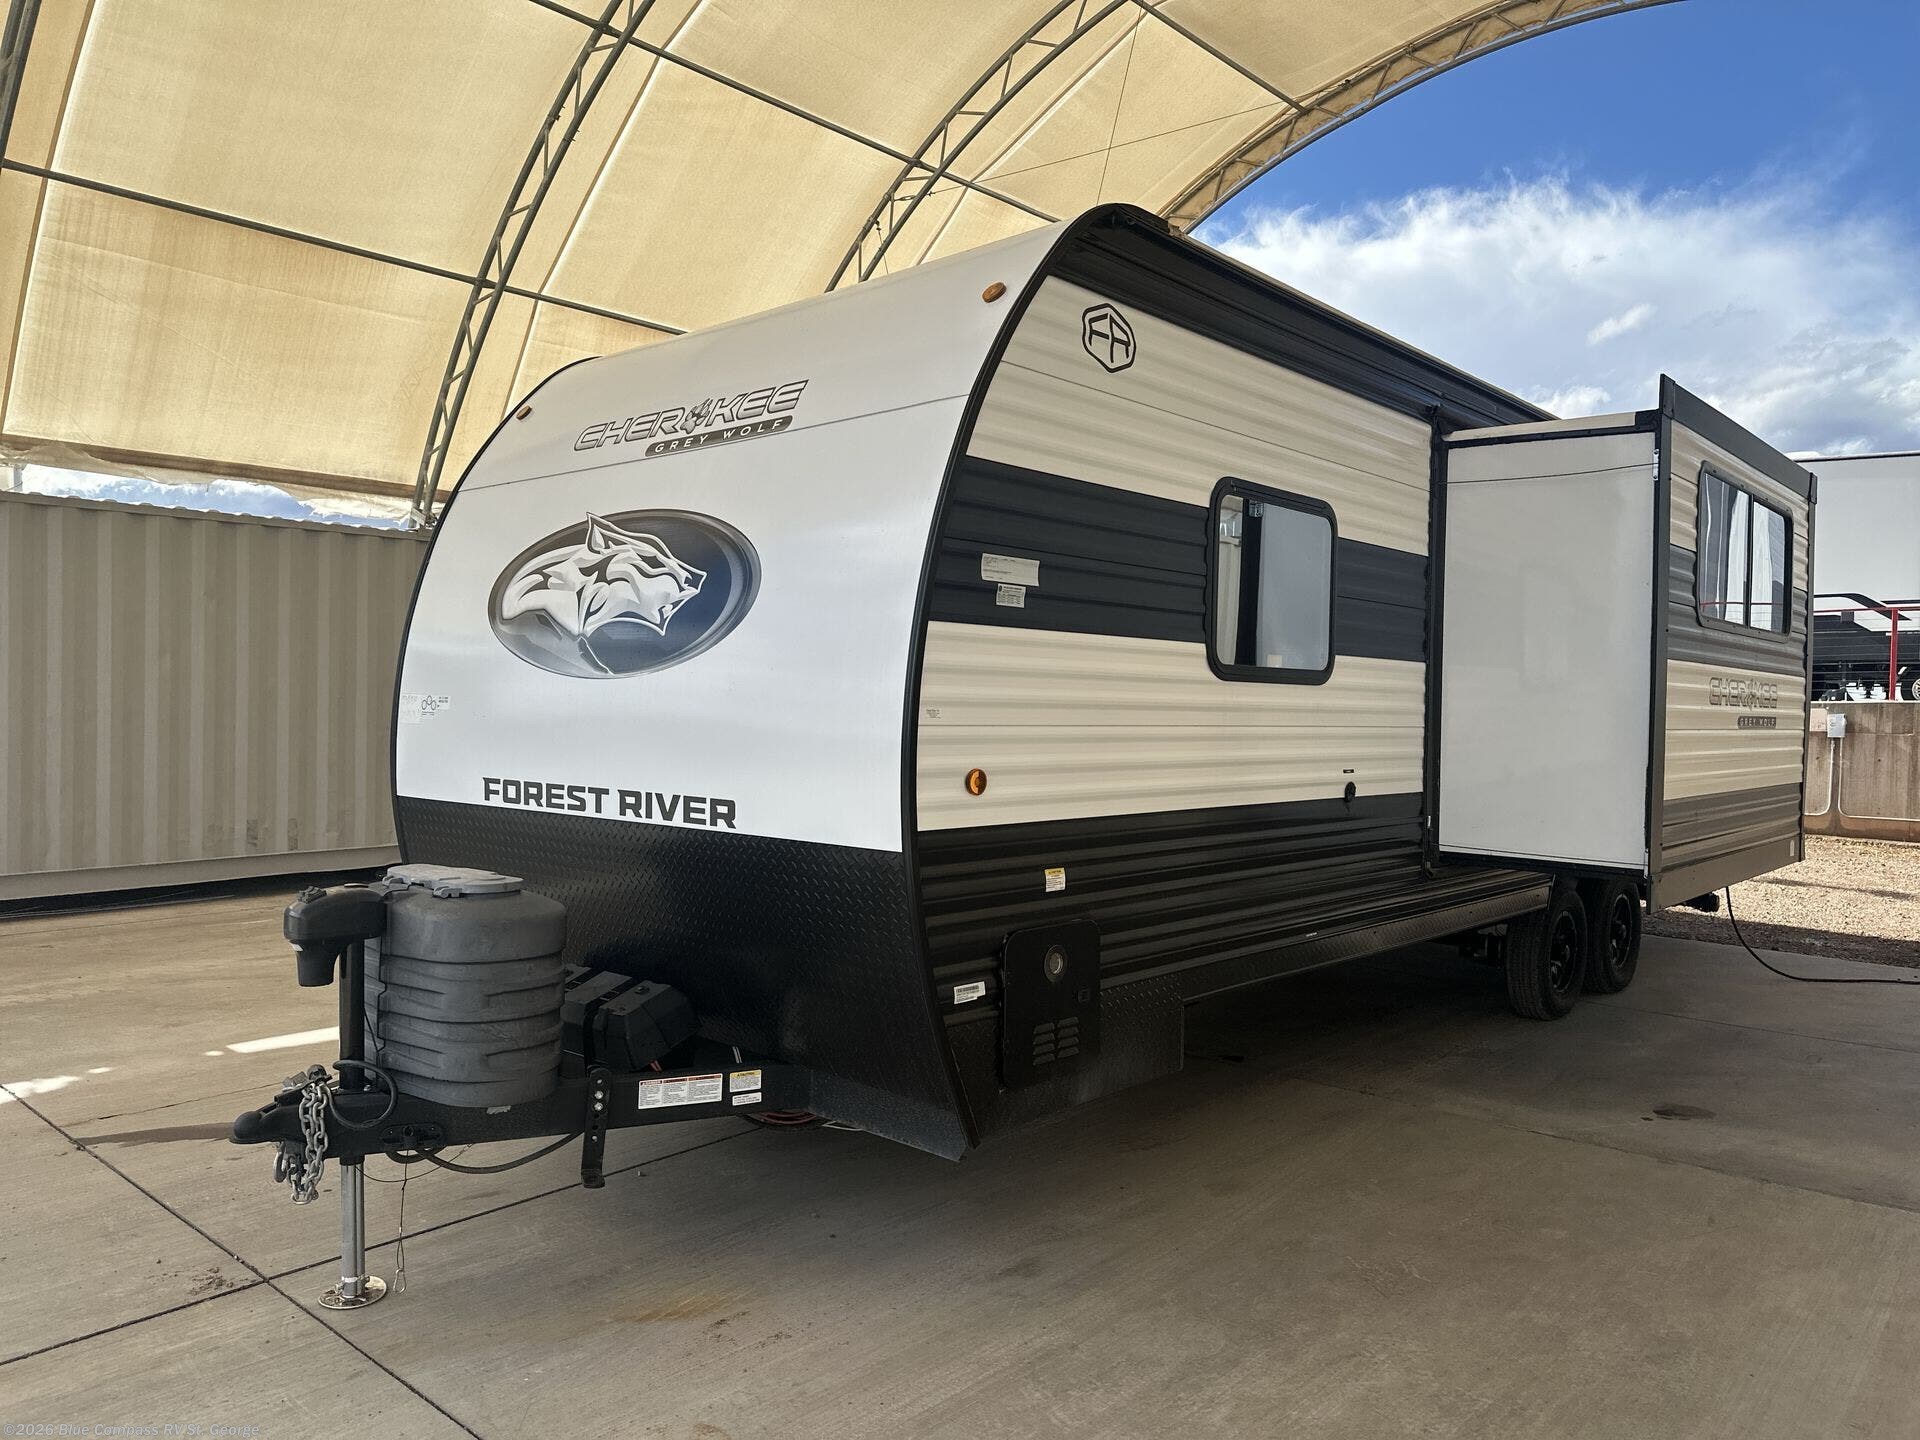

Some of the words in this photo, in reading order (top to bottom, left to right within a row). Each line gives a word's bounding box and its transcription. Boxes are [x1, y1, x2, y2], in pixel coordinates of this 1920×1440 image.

[654, 434, 709, 453] GREY
[722, 419, 784, 439] WOLF
[482, 776, 610, 814] FOREST
[617, 789, 737, 829] RIVER
